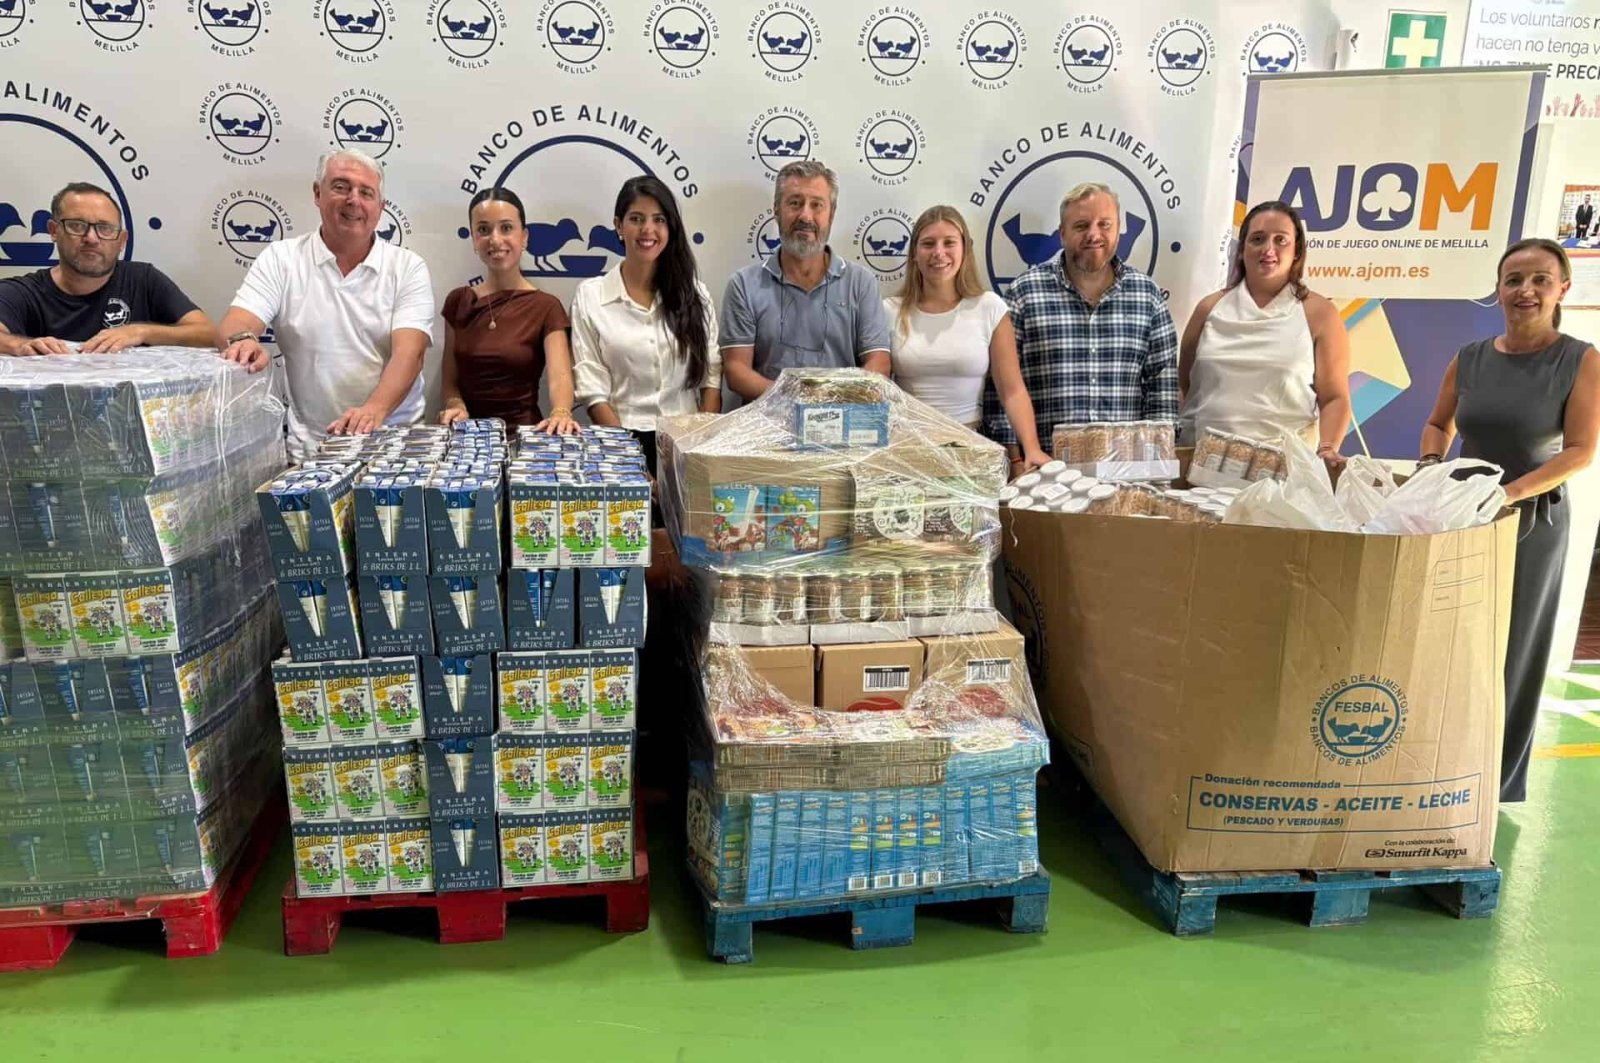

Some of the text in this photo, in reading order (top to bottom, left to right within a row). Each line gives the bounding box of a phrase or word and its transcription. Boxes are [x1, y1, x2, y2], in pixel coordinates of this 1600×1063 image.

[642, 3, 662, 38] BANCO
[747, 0, 822, 44] BANCO DE ALIMENTOS
[857, 5, 931, 49] BANCO DE ALIMENTOS
[1480, 8, 1507, 25] Los
[1511, 10, 1590, 29] voluntarios
[956, 10, 1028, 52] BANCO DE ALIMENTOS
[1052, 14, 1123, 56] BANCO DE ALIMENTOS
[1147, 19, 1216, 59] BANCO DE ALIMENTOS
[93, 38, 140, 53] MELILLA
[210, 43, 256, 57] MELILLA
[1239, 22, 1307, 63] BANCO DE ALIMENTOS
[1476, 33, 1521, 51] hacen
[1525, 40, 1544, 53] no
[1548, 38, 1589, 58] tenga
[335, 48, 379, 64] MELILLA
[447, 55, 490, 70] MELILLA
[556, 60, 598, 75] MELILLA
[661, 65, 702, 79] MELILLA
[764, 69, 804, 83] MELILLA
[873, 73, 912, 87] MELILLA
[971, 77, 1009, 91] MELILLA
[1066, 80, 1104, 94] MELILLA
[1160, 84, 1196, 97] MELILLA
[198, 82, 283, 126] BANCO DE ALIMENTOS
[322, 87, 405, 132] BANCO DE ALIMENTOS
[4, 80, 150, 182] ALIMENTOS
[746, 105, 820, 146] BANCO DE ALIMENTOS
[855, 109, 926, 149] BANCO DE ALIMENTOS
[222, 152, 266, 166] MELILLA
[461, 105, 698, 199] BANCO DE ALIMENTOS
[970, 121, 1181, 210] BANCO DE ALIMENTOS
[871, 173, 908, 186] MELILLA
[1278, 162, 1499, 232] AJOM
[210, 189, 294, 232] BANCO DE ALIMENTOS
[383, 199, 413, 237] MENTOS
[746, 213, 765, 244] BANCO
[852, 215, 871, 246] BANCO
[872, 208, 884, 218] DE
[1327, 240, 1340, 249] DE
[1343, 239, 1378, 249] JUEGO
[1382, 239, 1422, 249] ONLINE
[1424, 239, 1439, 249] DE
[1441, 239, 1489, 249] MELILLA
[1308, 263, 1430, 281] www.ajom.es
[287, 568, 312, 577] BRIKS
[313, 566, 322, 575] DE
[370, 562, 394, 571] BRIKS
[396, 562, 406, 570] DE
[444, 564, 468, 572] BRIKS
[1312, 674, 1409, 716] BANCOS DE ALIMENTOS
[1334, 702, 1389, 712] FESBAL
[1310, 726, 1406, 767] BANCOS DE ALIMENTOS
[1205, 774, 1341, 788] Donación recomendada
[1200, 792, 1318, 812] CONSERVAS
[1334, 796, 1403, 811] ACEITE
[1418, 789, 1470, 809] LECHE
[1223, 816, 1344, 827] (PESCADO Y VERDURAS)
[1386, 848, 1468, 859] Smurfit Kappa
